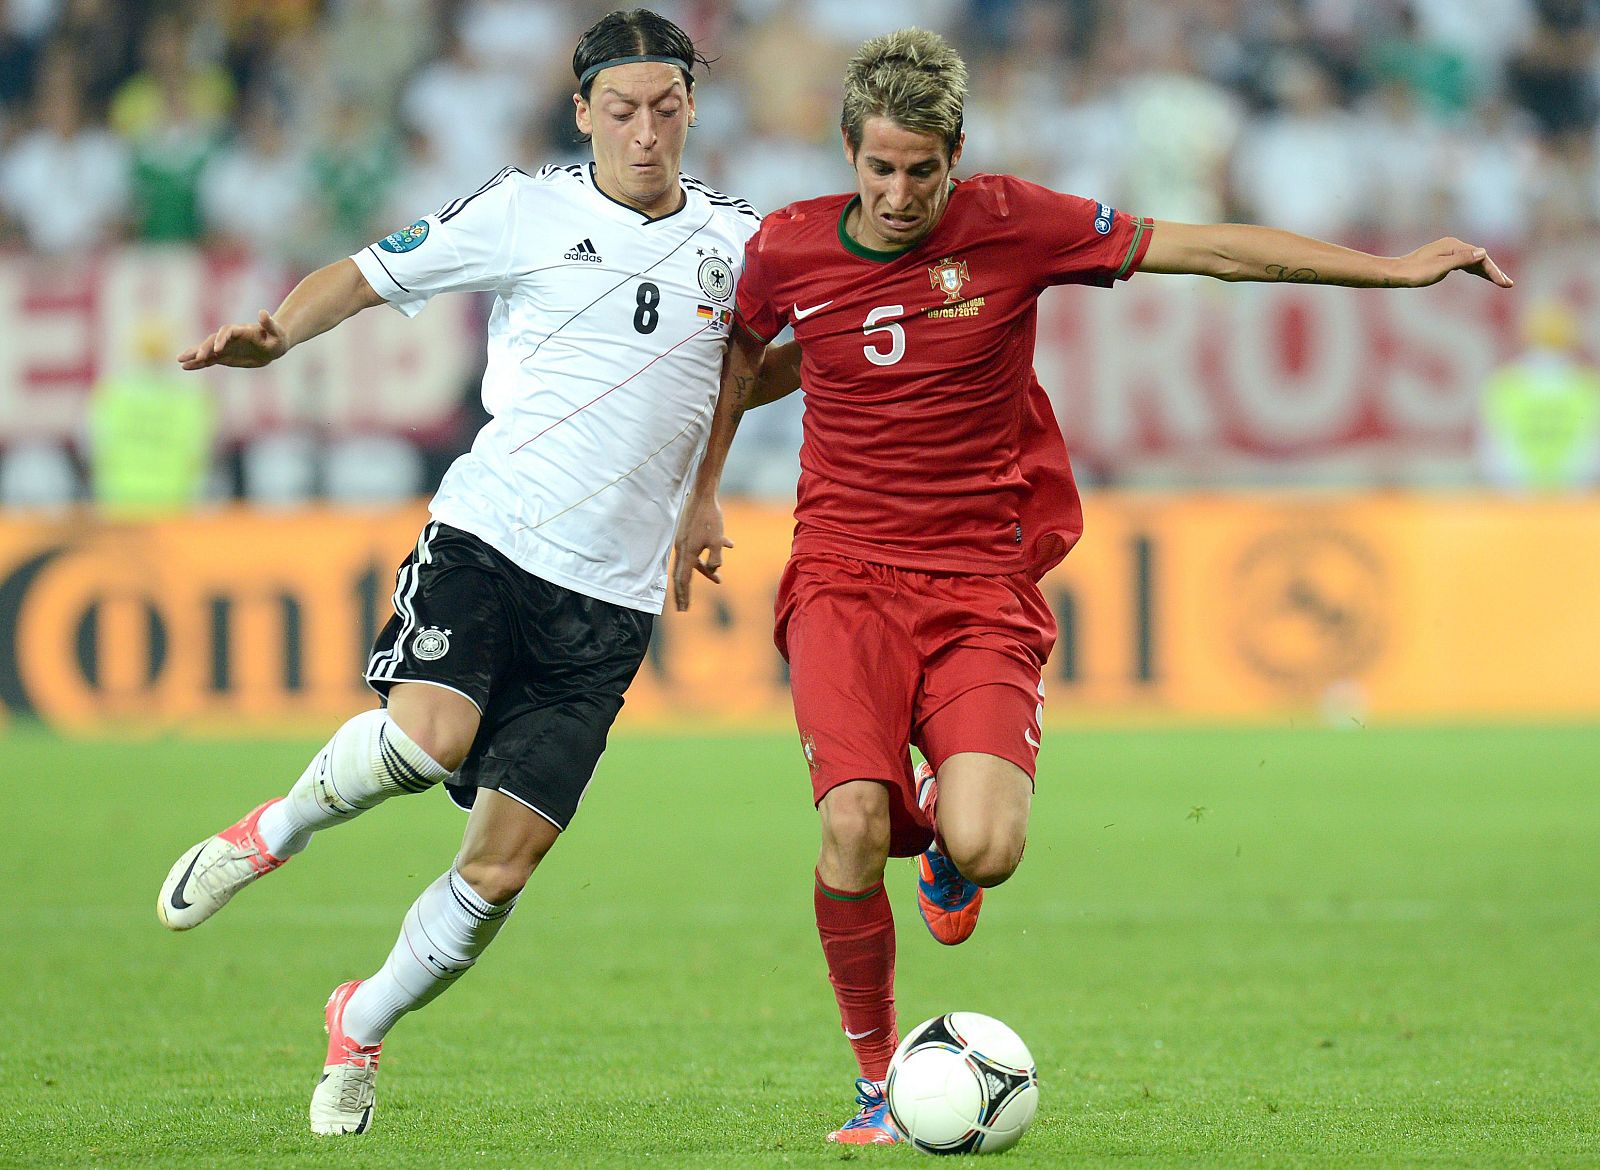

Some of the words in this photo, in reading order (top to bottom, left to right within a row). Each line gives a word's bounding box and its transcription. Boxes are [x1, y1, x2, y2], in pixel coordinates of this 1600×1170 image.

[564, 252, 602, 263] adidas
[633, 282, 660, 335] 8
[862, 304, 906, 366] 5
